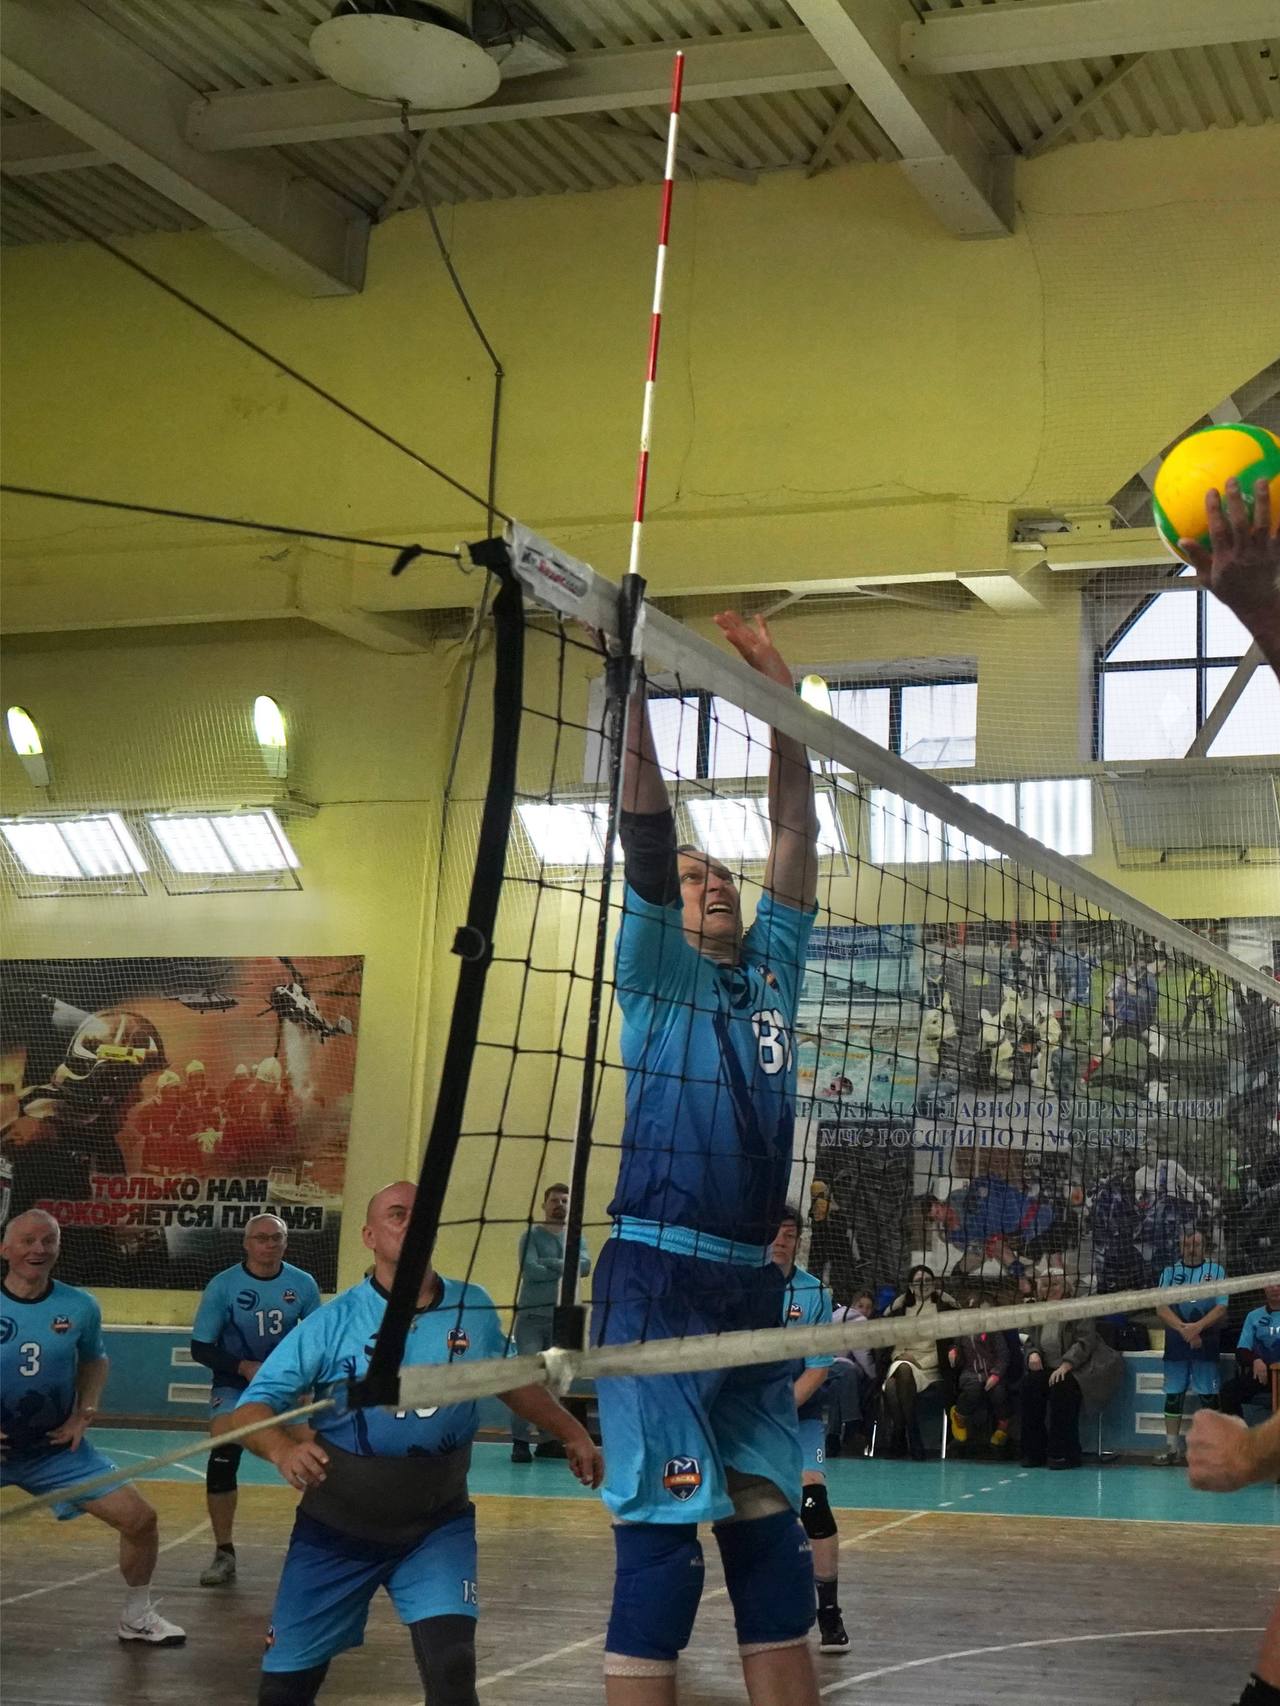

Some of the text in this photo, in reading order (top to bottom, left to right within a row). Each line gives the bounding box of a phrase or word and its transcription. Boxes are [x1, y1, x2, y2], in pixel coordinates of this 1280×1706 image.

[789, 1100, 1223, 1121] РТАКИАДА ГЛАВНОГО УПРАВЛЕНИЯ
[820, 1128, 875, 1148] МЧС
[878, 1128, 973, 1148] РОССИИ
[979, 1128, 1014, 1147] ПО
[1046, 1128, 1147, 1149] МОСКВЕ
[91, 1176, 268, 1203] ТОЛЬКО НАМ
[255, 1309, 283, 1337] 13
[19, 1342, 41, 1378] 3
